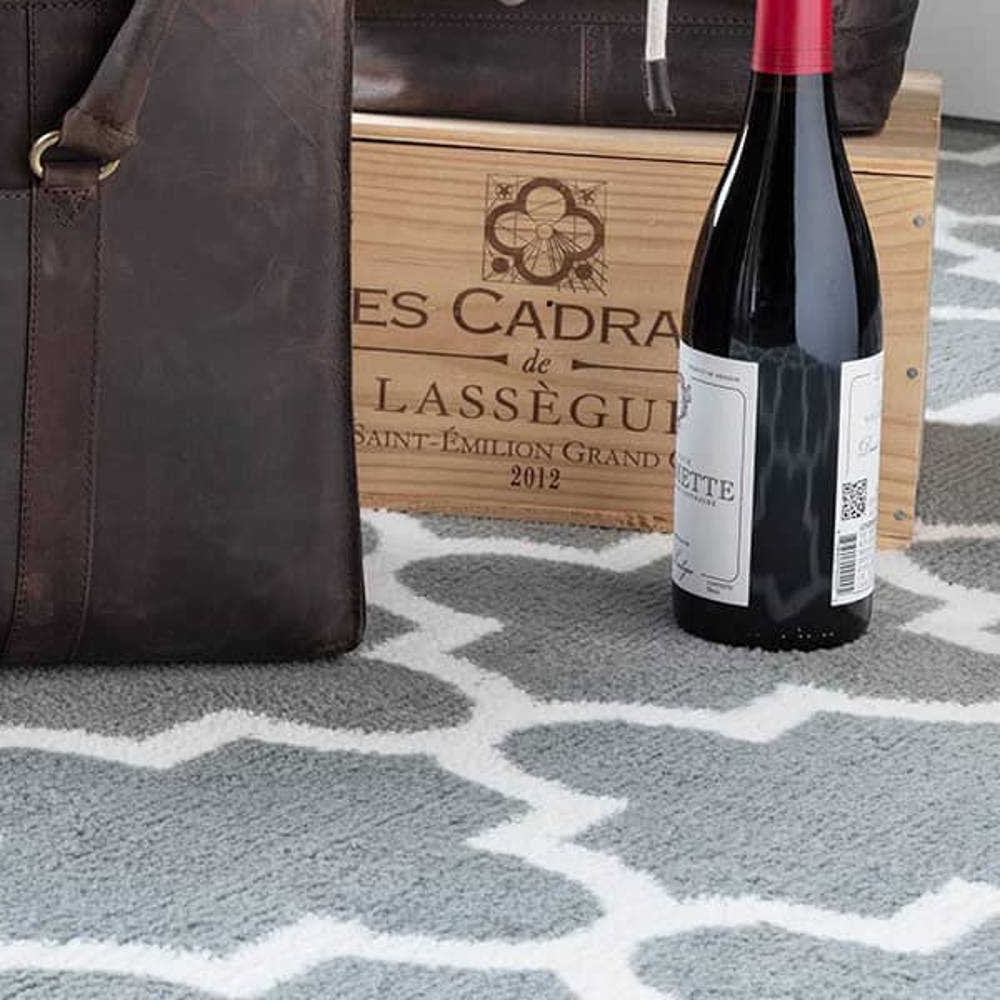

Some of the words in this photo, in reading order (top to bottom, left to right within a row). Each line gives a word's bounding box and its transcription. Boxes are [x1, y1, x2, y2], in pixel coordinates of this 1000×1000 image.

[521, 348, 552, 374] de
[562, 440, 661, 469] GRAND
[510, 464, 561, 490] 2012
[678, 464, 735, 502] ETTE
